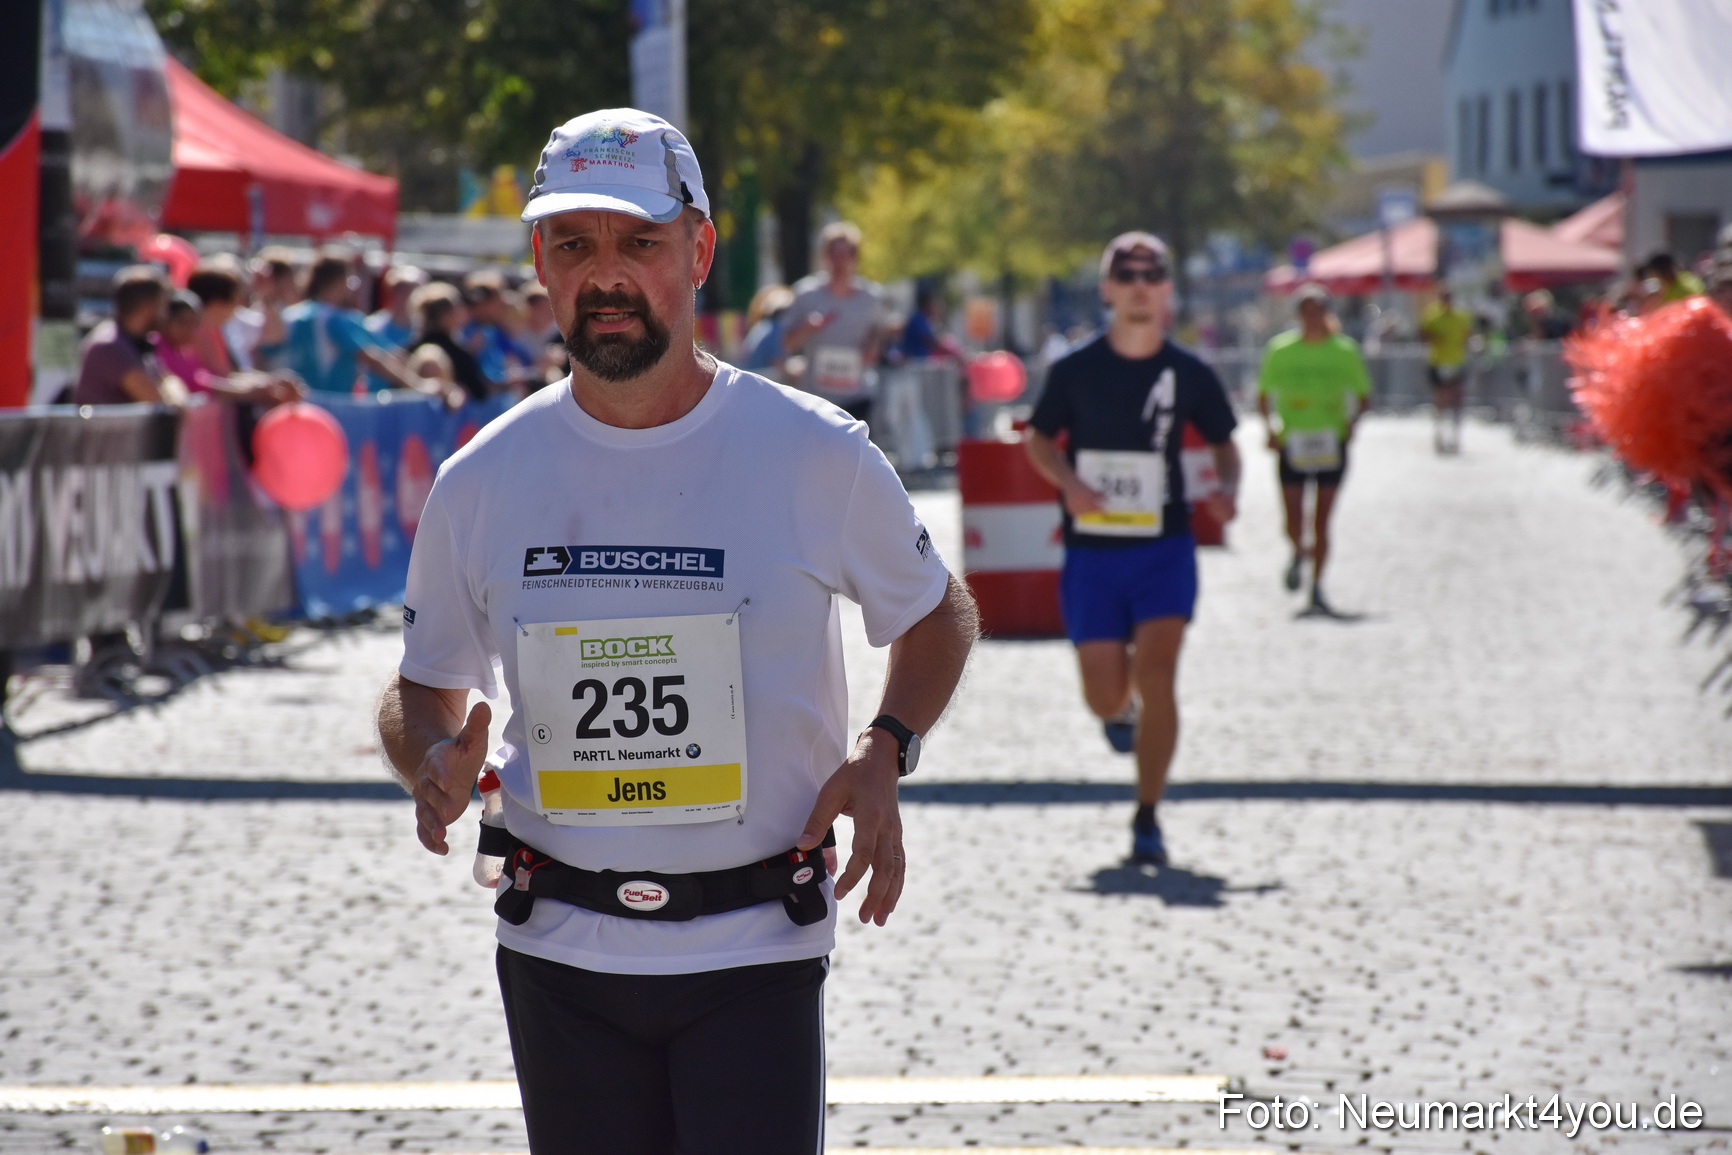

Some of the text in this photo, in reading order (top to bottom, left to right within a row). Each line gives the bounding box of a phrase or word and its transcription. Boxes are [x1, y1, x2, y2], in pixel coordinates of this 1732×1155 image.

[584, 147, 635, 157] FRÄNKISCHE
[589, 160, 635, 169] MARATHON
[579, 551, 716, 572] BÜSCHEL
[521, 578, 724, 592] FEINSCHNEIDTECHNIK WERKZEUGBAU
[580, 634, 677, 661] BOCK
[580, 660, 610, 669] inspired
[610, 660, 620, 668] by
[644, 657, 678, 666] concepts
[571, 674, 690, 740] 235
[537, 728, 546, 740] C
[573, 750, 616, 762] PARTL
[618, 747, 681, 761] Neumarkt
[607, 777, 667, 802] Jens
[623, 889, 644, 897] Fuel
[641, 894, 662, 902] Belt
